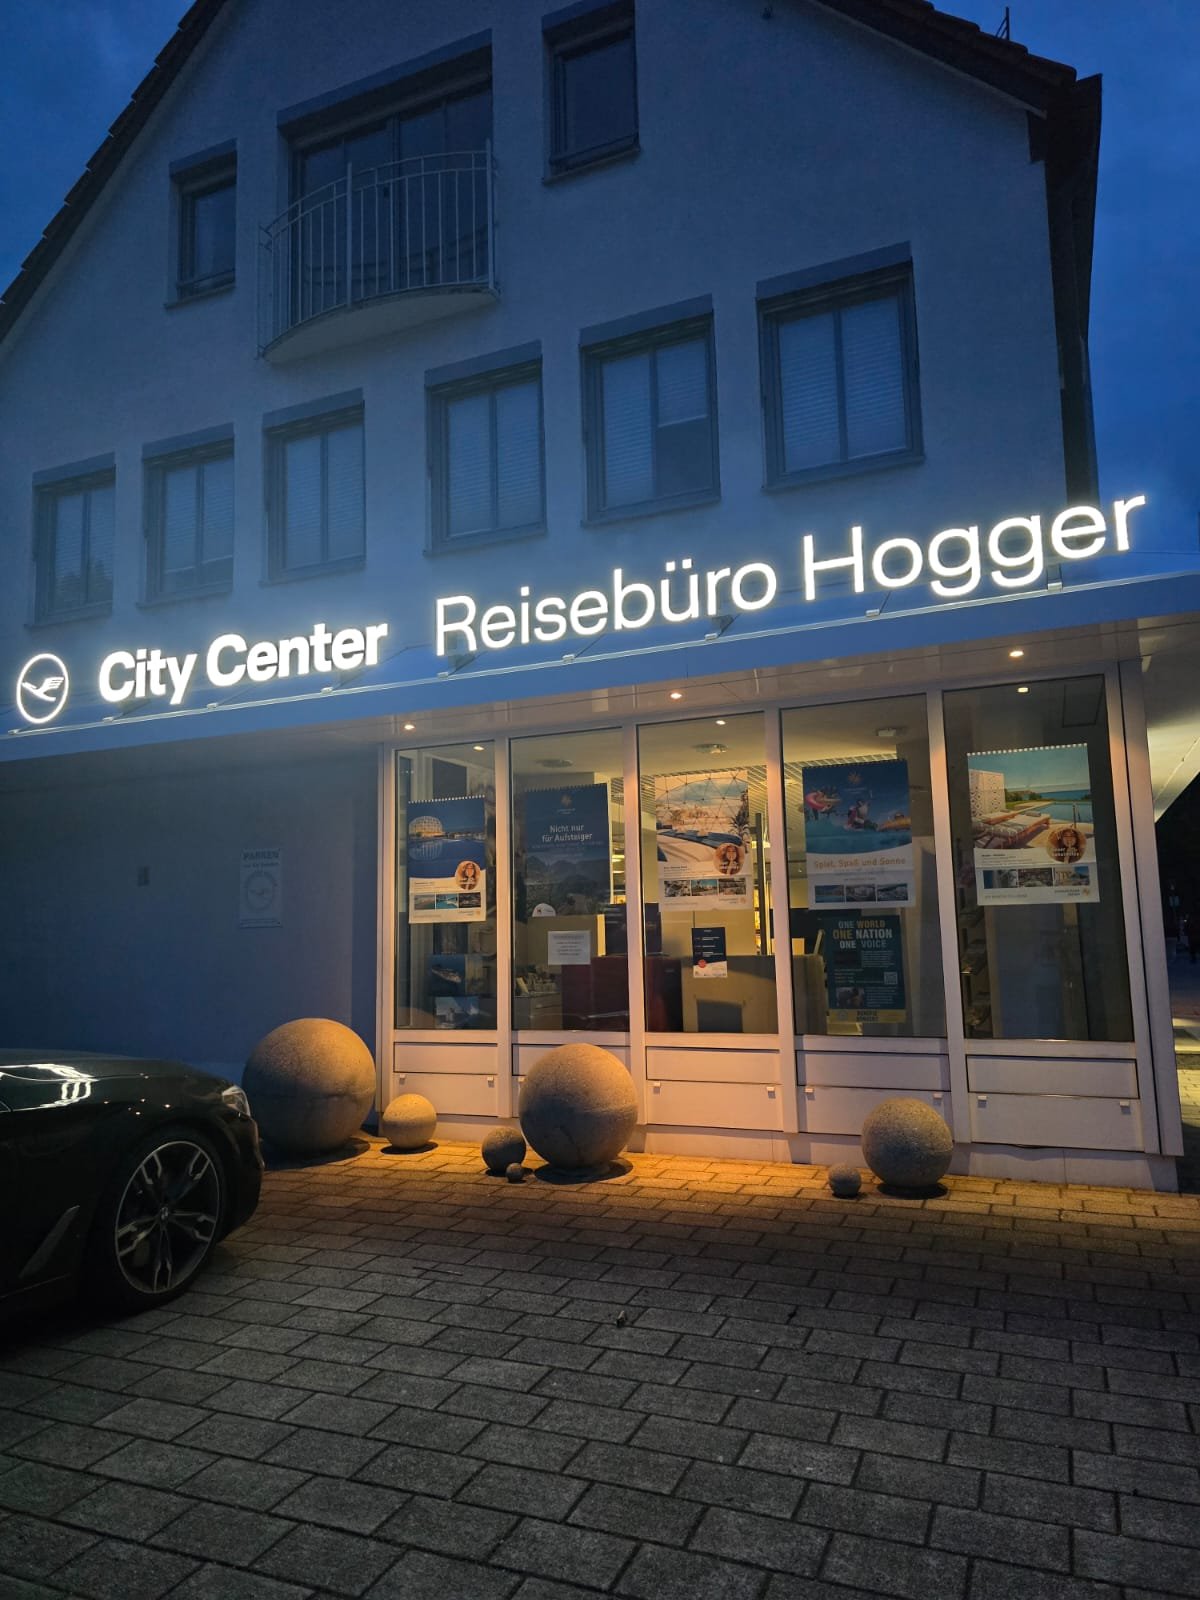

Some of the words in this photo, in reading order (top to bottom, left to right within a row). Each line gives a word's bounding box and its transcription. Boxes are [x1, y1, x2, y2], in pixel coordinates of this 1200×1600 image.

[99, 649, 197, 704] City
[207, 623, 387, 686] Center
[437, 559, 776, 656] Reisebüro
[804, 496, 1145, 600] Hogger
[550, 825, 569, 833] Nicht
[542, 834, 553, 843] für
[554, 833, 592, 842] Aufsteiger
[862, 858, 877, 866] und
[880, 857, 905, 865] Sonne
[838, 920, 854, 929] ONE
[857, 920, 885, 928] WORLD
[833, 929, 853, 939] ONE
[856, 928, 893, 939] NATION
[839, 940, 856, 949] ONE
[861, 939, 887, 948] VOICE
